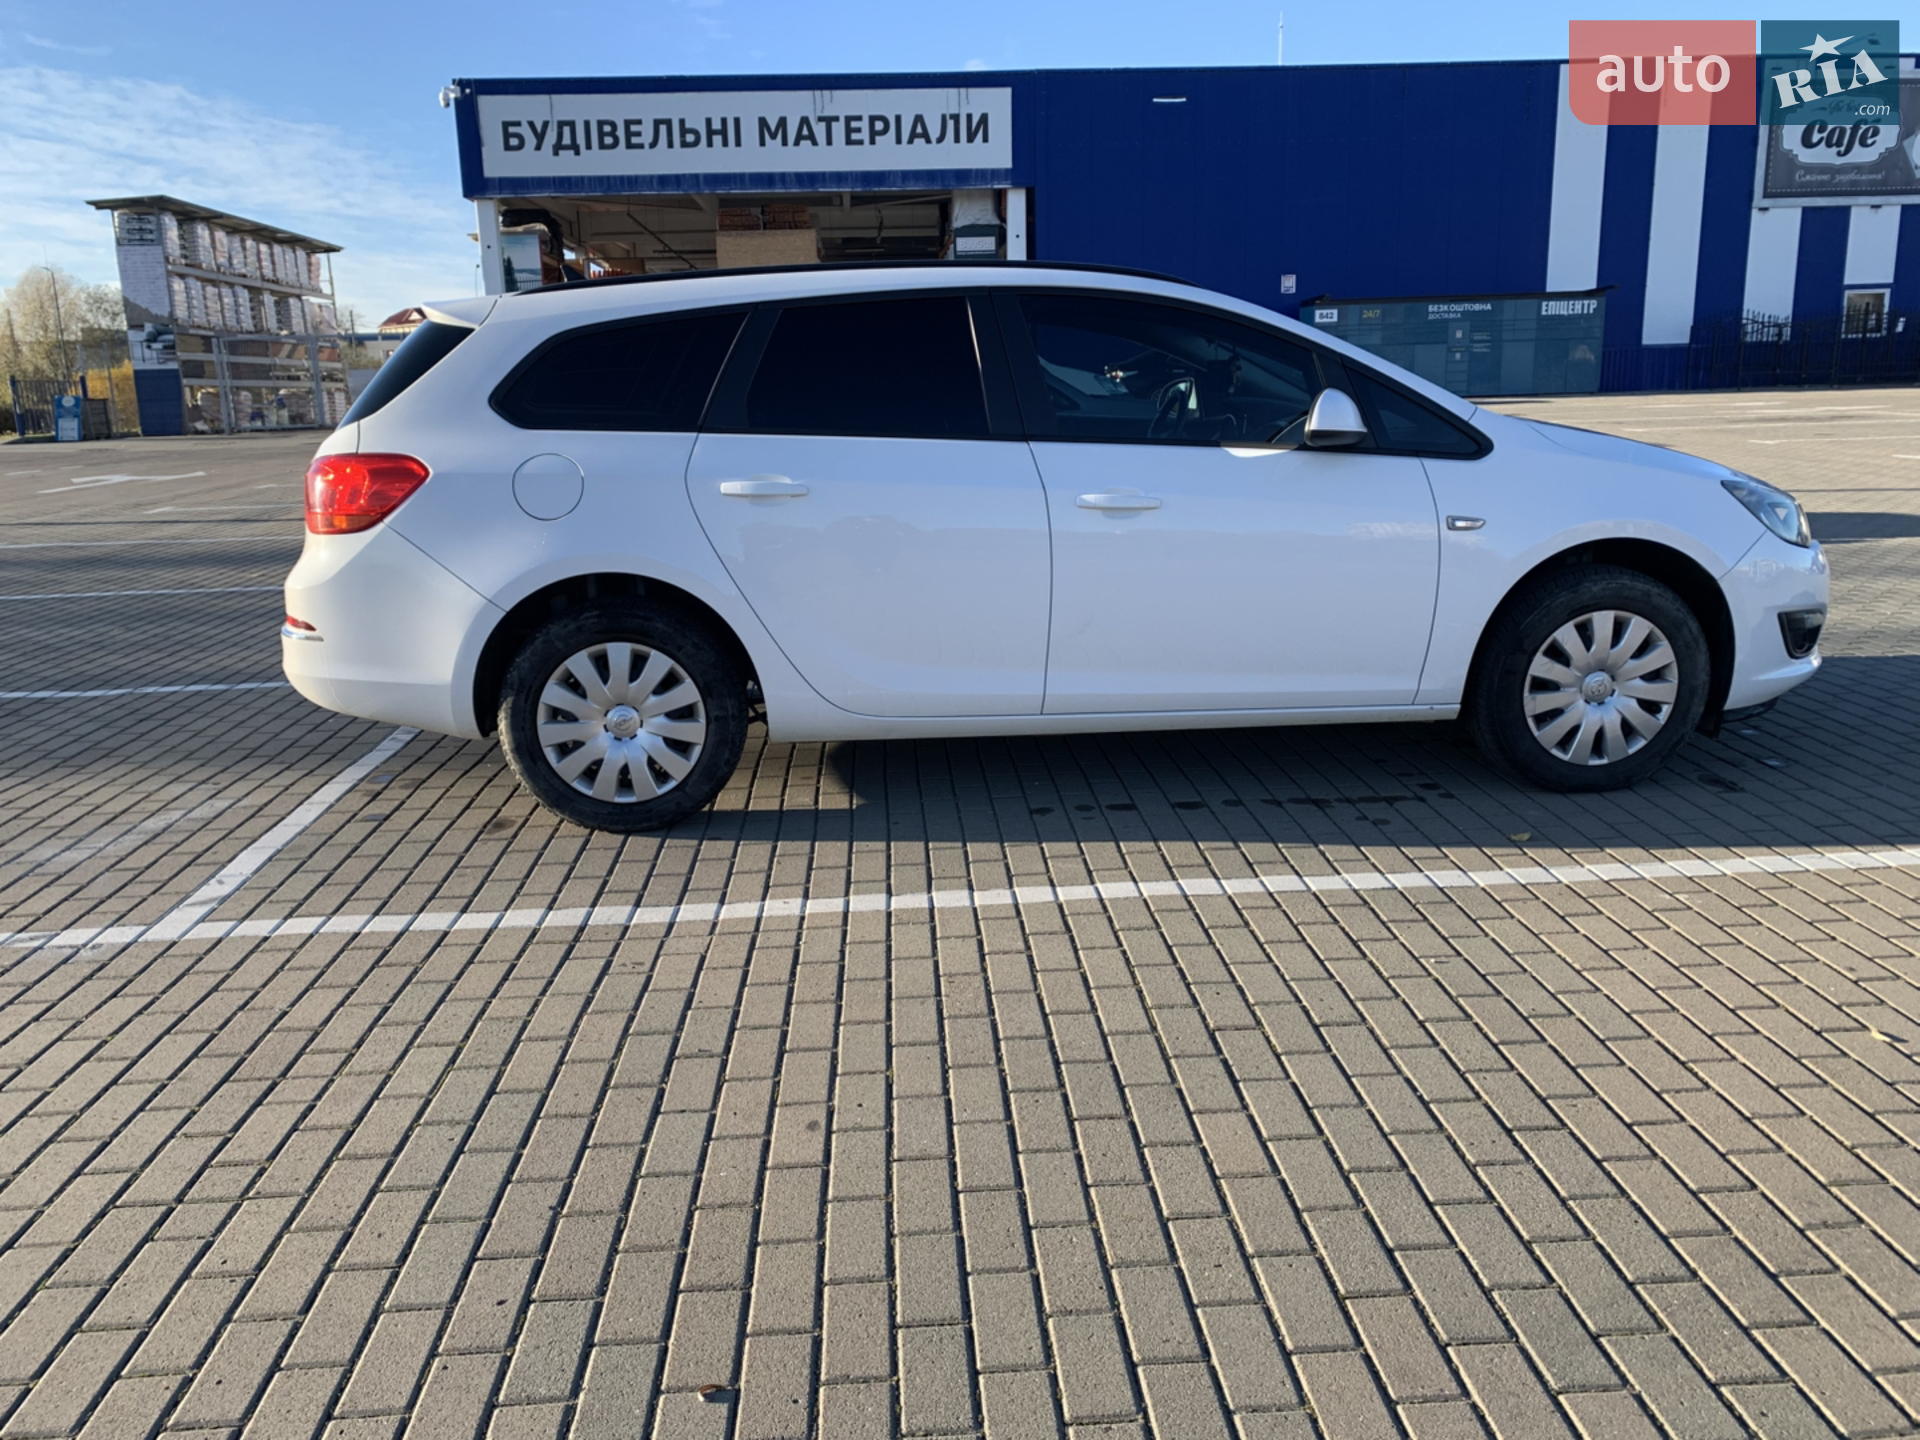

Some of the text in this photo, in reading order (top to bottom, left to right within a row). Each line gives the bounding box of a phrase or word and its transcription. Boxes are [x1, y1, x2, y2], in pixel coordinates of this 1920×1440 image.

[501, 112, 990, 156] БУДІВЕЛЬНІ МАТЕРІАЛИ
[1800, 117, 1883, 157] Café
[1427, 303, 1492, 312] БЕЗКОШТОВНА
[1541, 300, 1598, 316] ЕПІЦЕНТР
[1318, 311, 1335, 320] 842
[1362, 309, 1380, 318] 24/7
[1427, 312, 1462, 320] ДОСТАВКА
